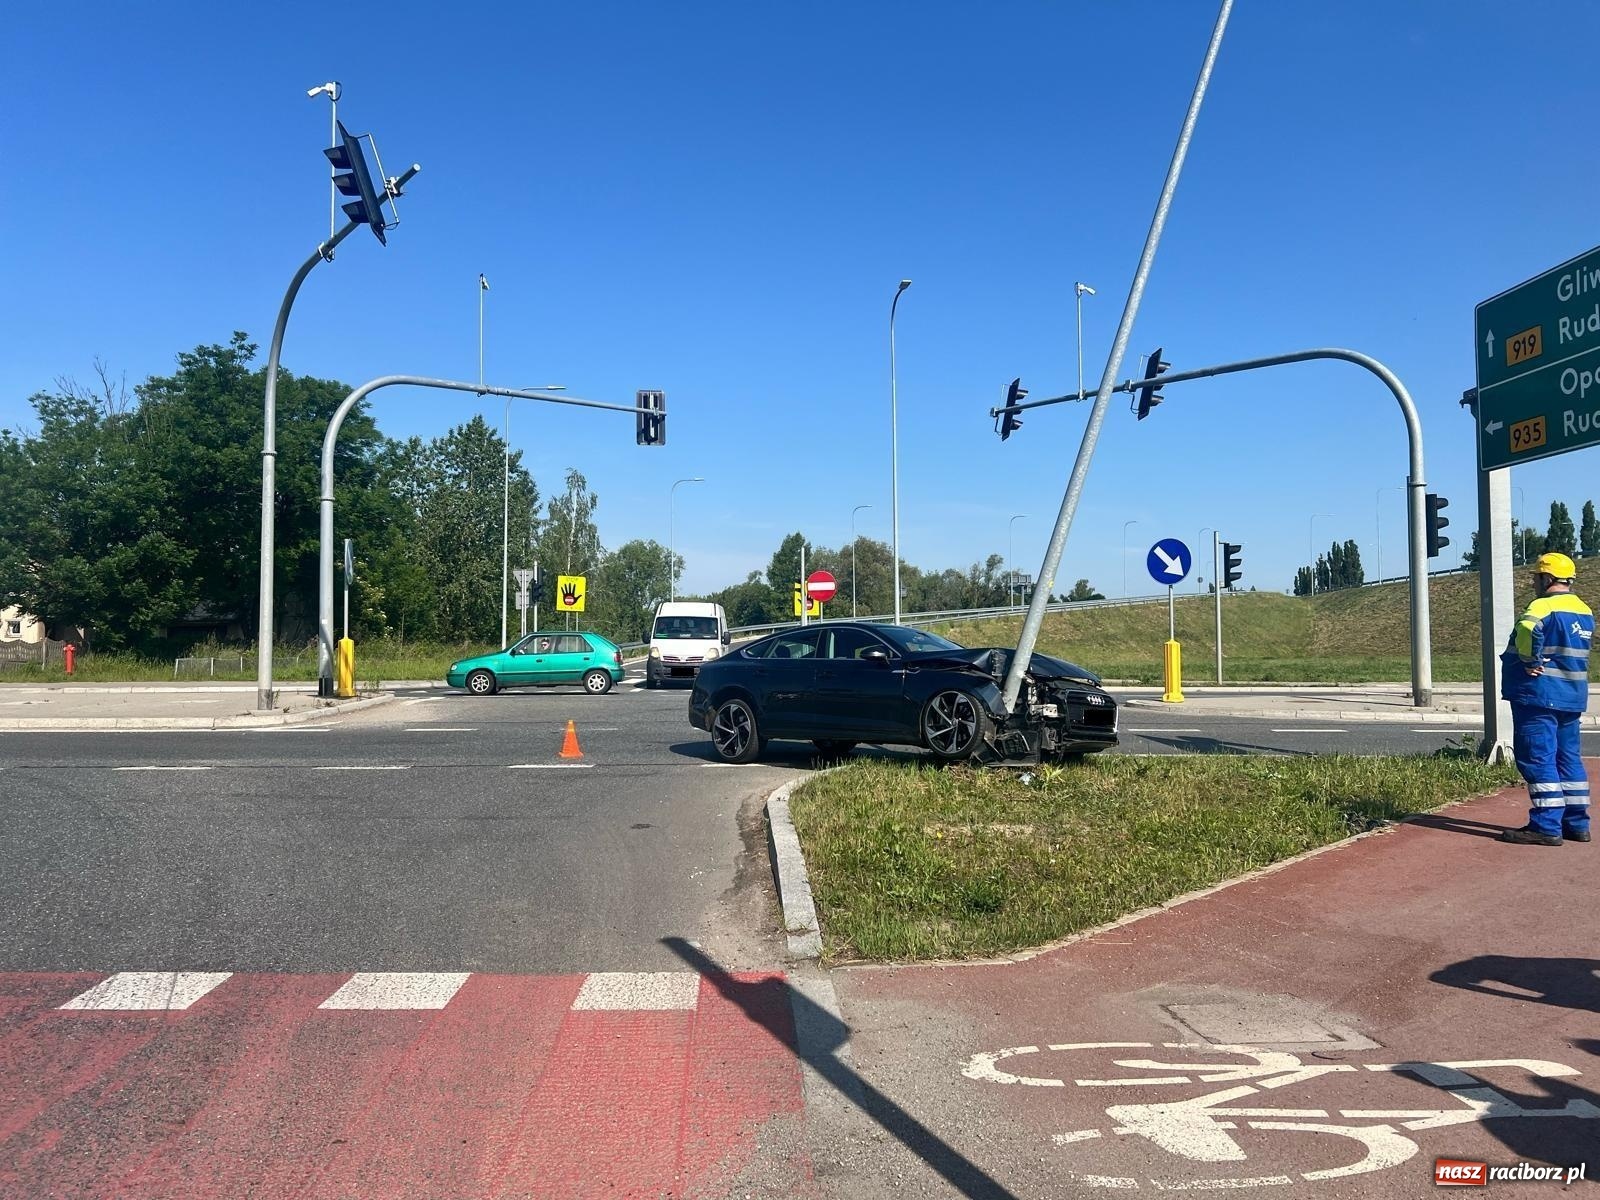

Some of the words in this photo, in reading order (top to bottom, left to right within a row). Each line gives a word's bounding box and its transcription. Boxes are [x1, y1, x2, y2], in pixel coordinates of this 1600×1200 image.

[1559, 303, 1600, 345] Rud
[1512, 333, 1537, 361] 919
[1512, 421, 1542, 449] 935
